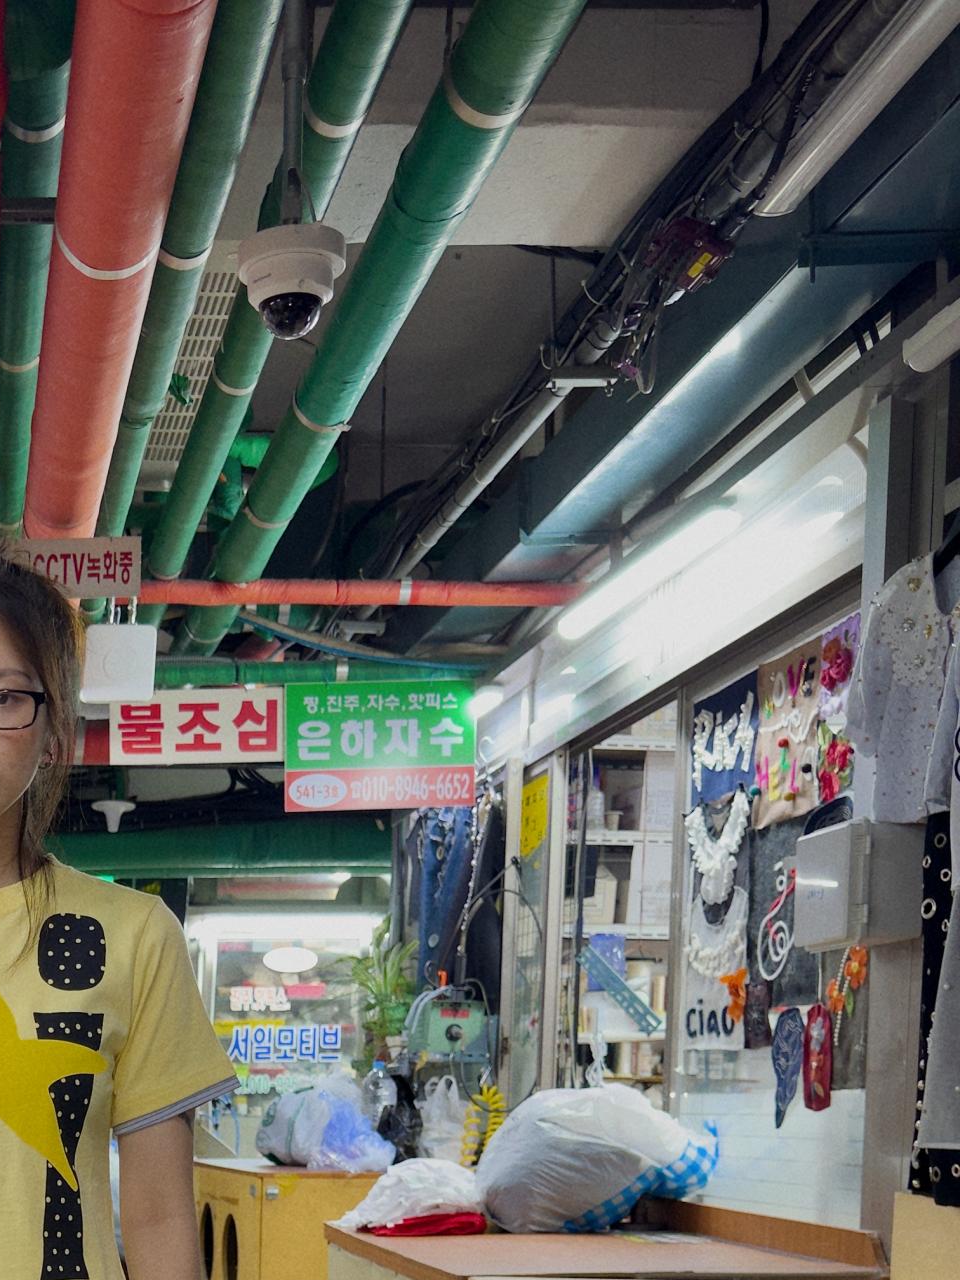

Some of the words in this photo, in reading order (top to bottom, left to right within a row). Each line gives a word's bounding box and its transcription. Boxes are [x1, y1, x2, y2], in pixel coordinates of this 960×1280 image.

[118, 699, 278, 755] 불조심
[297, 717, 465, 760] 은하자수
[362, 772, 470, 802] 010-8946-6652
[228, 1025, 341, 1062] 서일모티브
